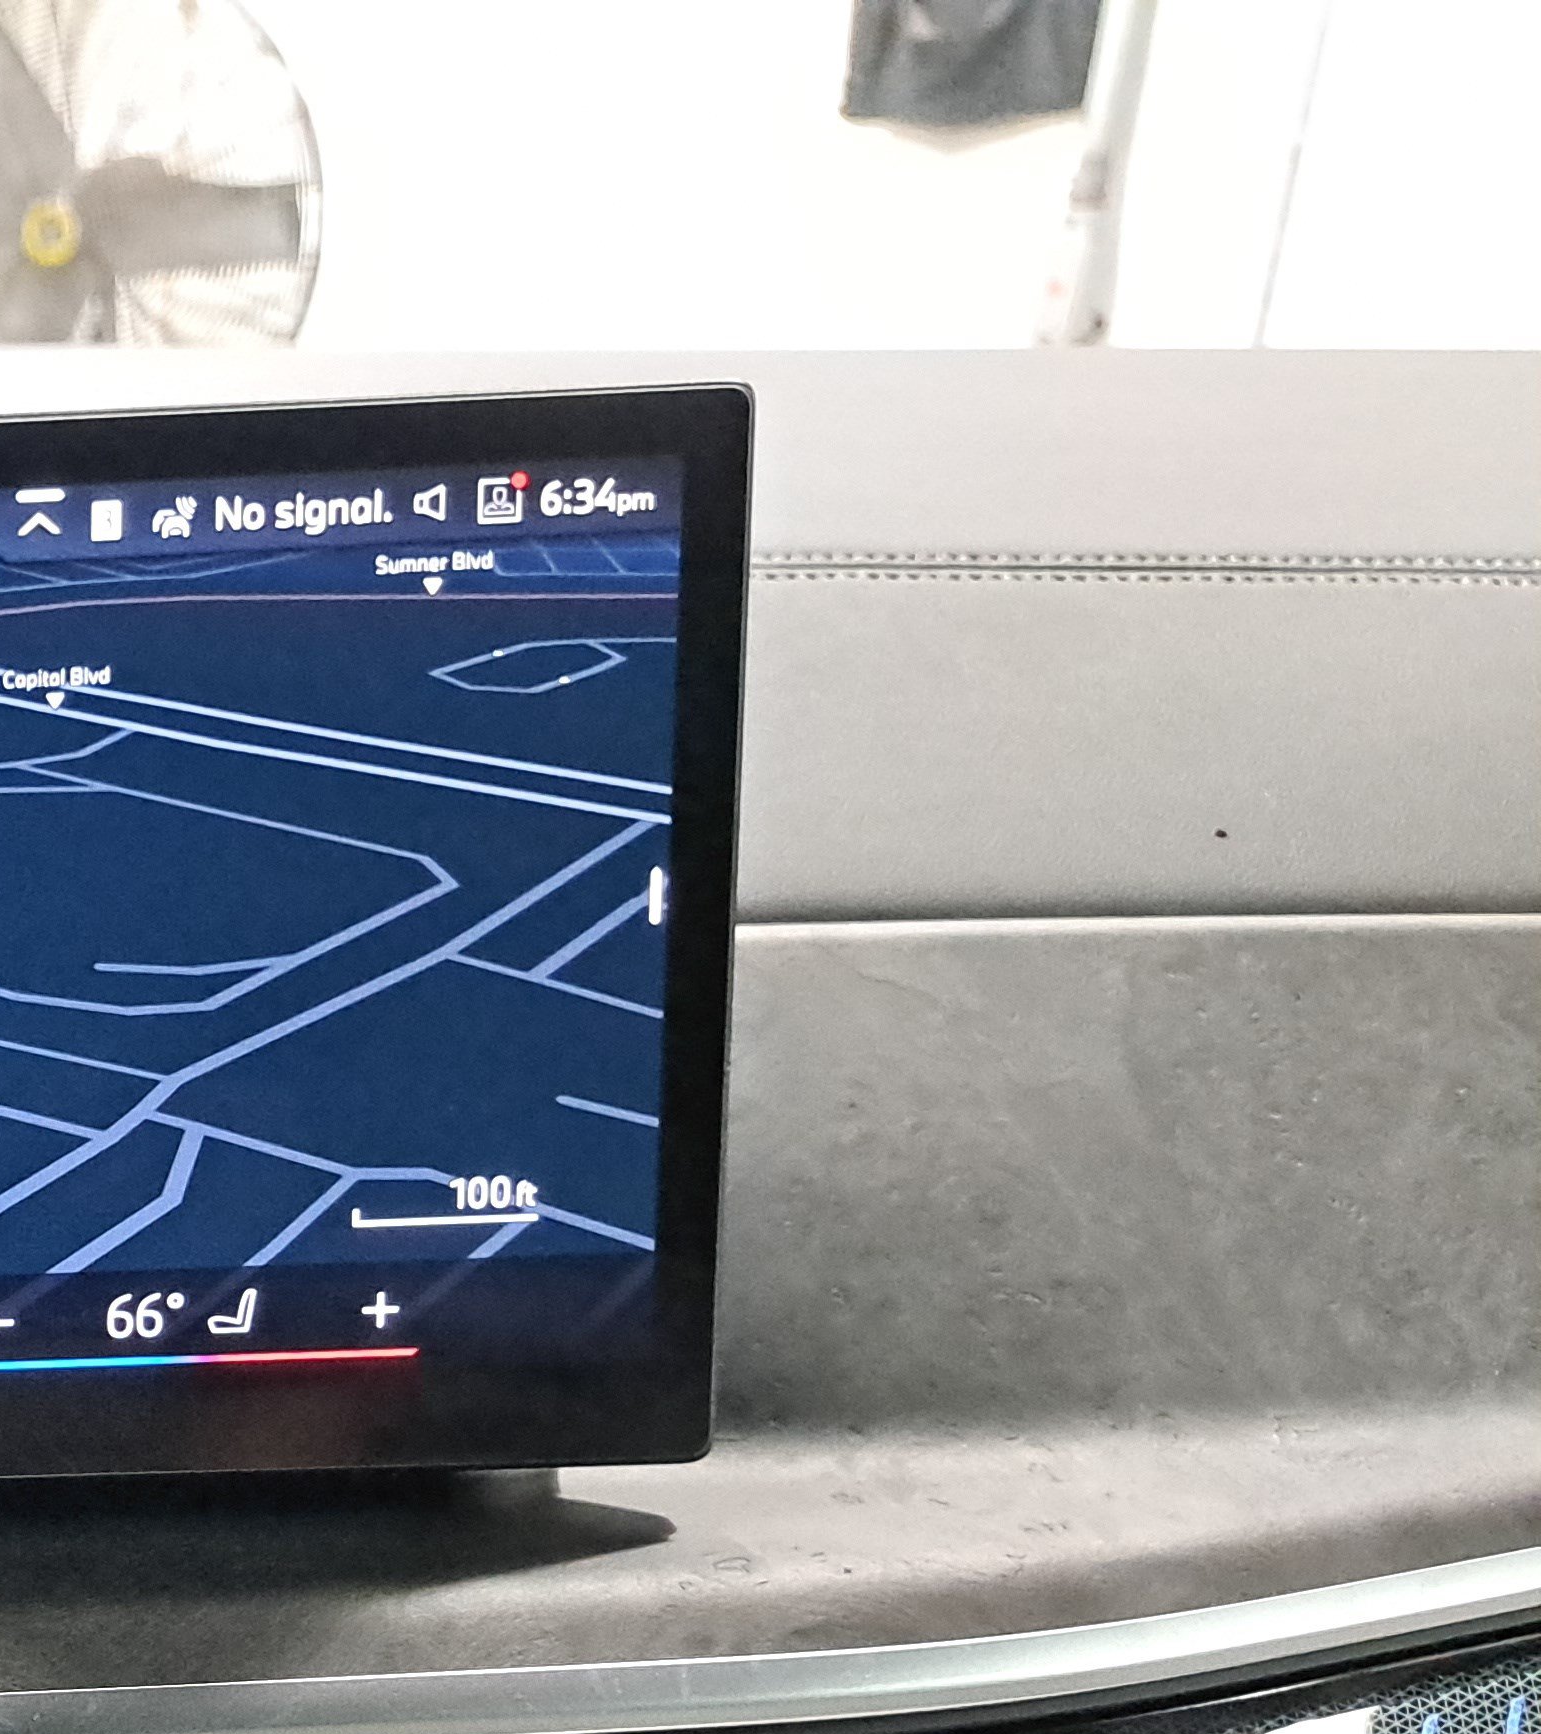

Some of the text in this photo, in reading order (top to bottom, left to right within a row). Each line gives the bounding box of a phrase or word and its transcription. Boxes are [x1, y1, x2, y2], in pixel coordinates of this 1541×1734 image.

[215, 488, 394, 534] No signal.
[540, 478, 655, 517] 6:34pm
[375, 549, 495, 575] Sumner Blvd
[2, 665, 111, 691] Capital Blvd
[449, 1175, 538, 1210] 100 ft
[106, 1292, 185, 1339] 66°
